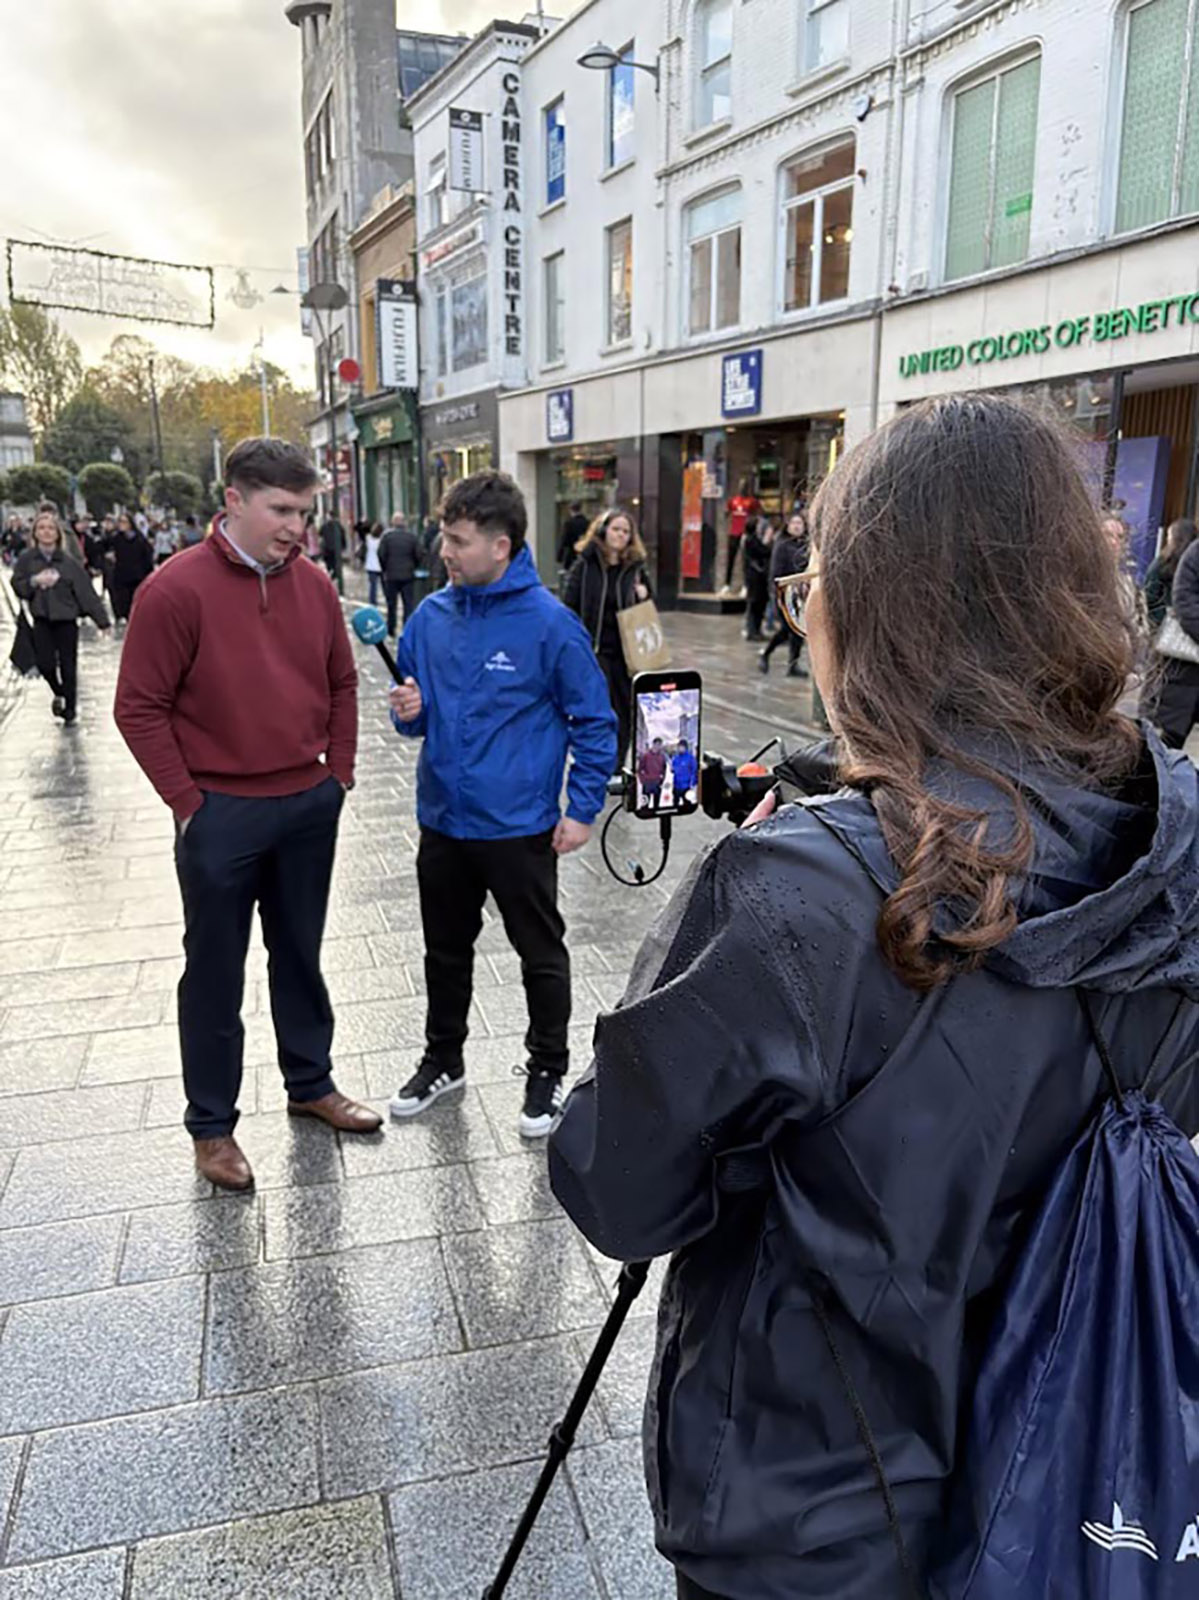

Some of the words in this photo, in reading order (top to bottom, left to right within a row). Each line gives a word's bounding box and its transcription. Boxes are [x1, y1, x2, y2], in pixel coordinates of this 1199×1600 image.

[502, 73, 521, 213] CAMERA
[504, 224, 522, 356] CENTRE
[899, 344, 964, 378] UNITED
[966, 325, 1052, 366] COLORS
[1054, 315, 1091, 349] OF
